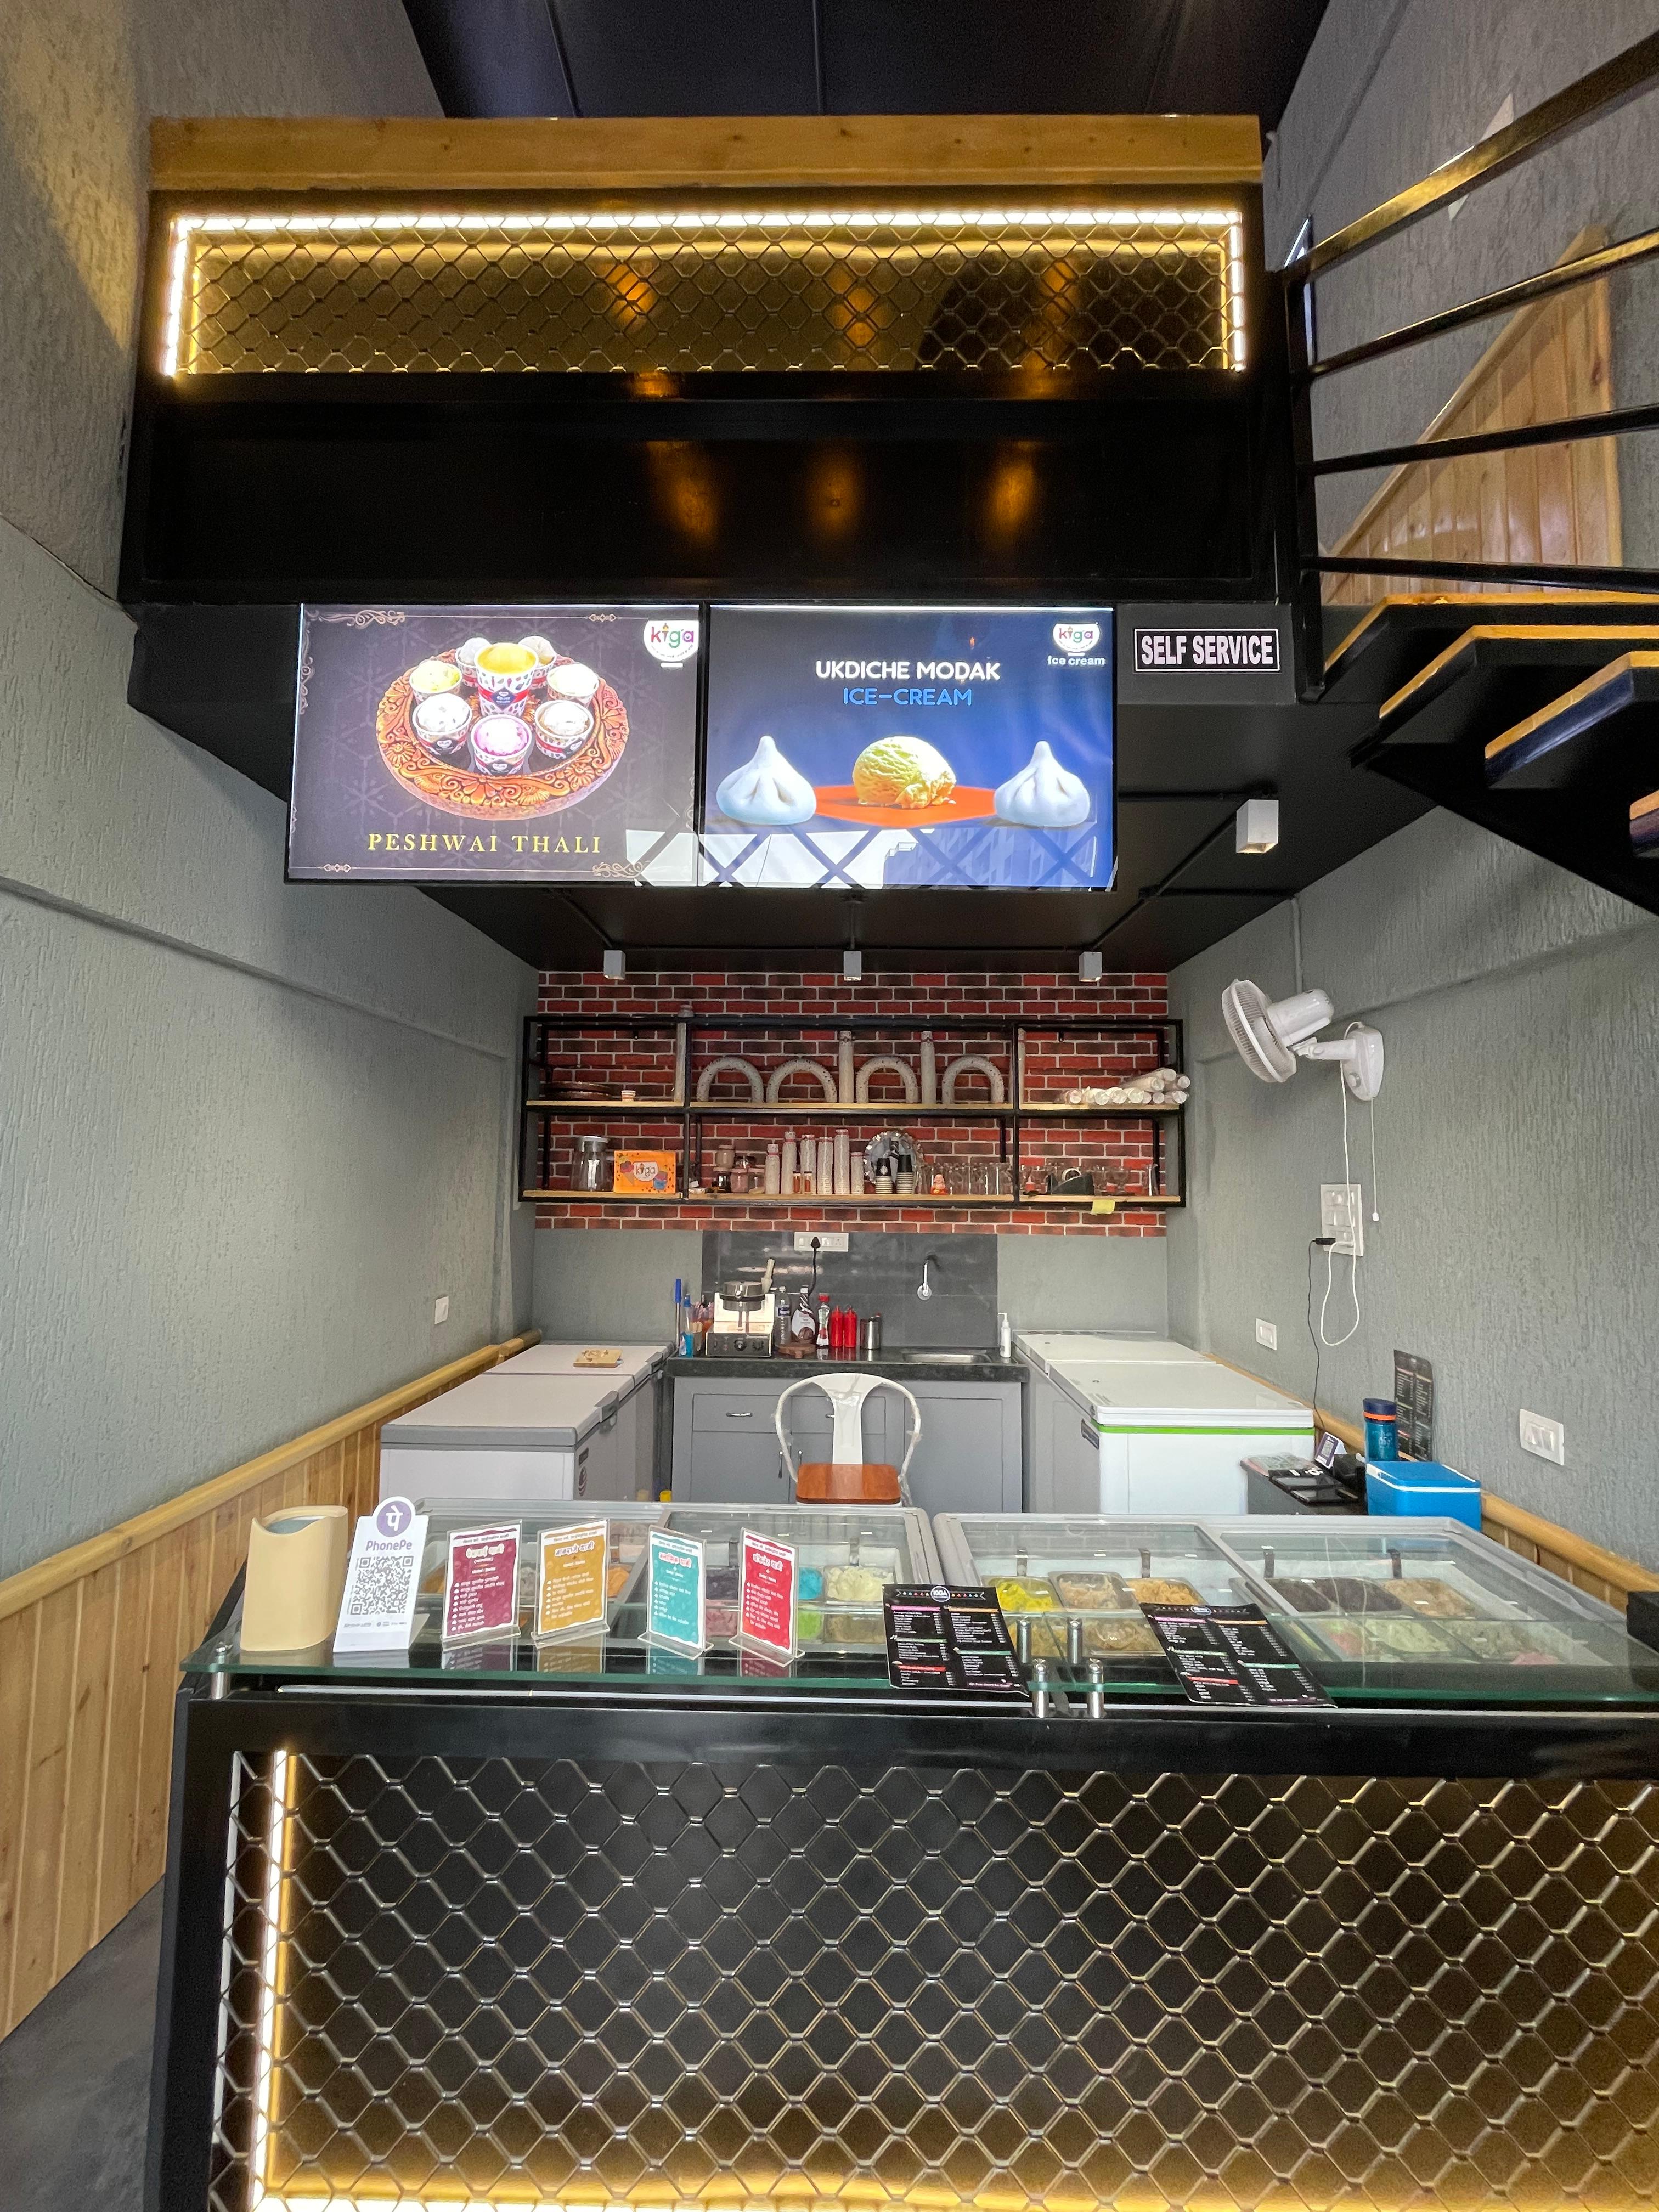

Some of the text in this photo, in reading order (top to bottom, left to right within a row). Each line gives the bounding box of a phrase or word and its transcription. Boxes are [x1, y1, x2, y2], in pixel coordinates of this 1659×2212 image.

[651, 623, 694, 648] kiga
[1059, 626, 1093, 643] kiga
[1141, 635, 1273, 664] SELF SERVICE
[816, 661, 1001, 680] UKDICHE MODAK
[1068, 657, 1105, 665] cream
[844, 687, 972, 706] ICE-CREAM
[368, 833, 600, 853] PESHWAI THALI
[386, 1505, 404, 1531] पे
[366, 1539, 413, 1551] PhonePe
